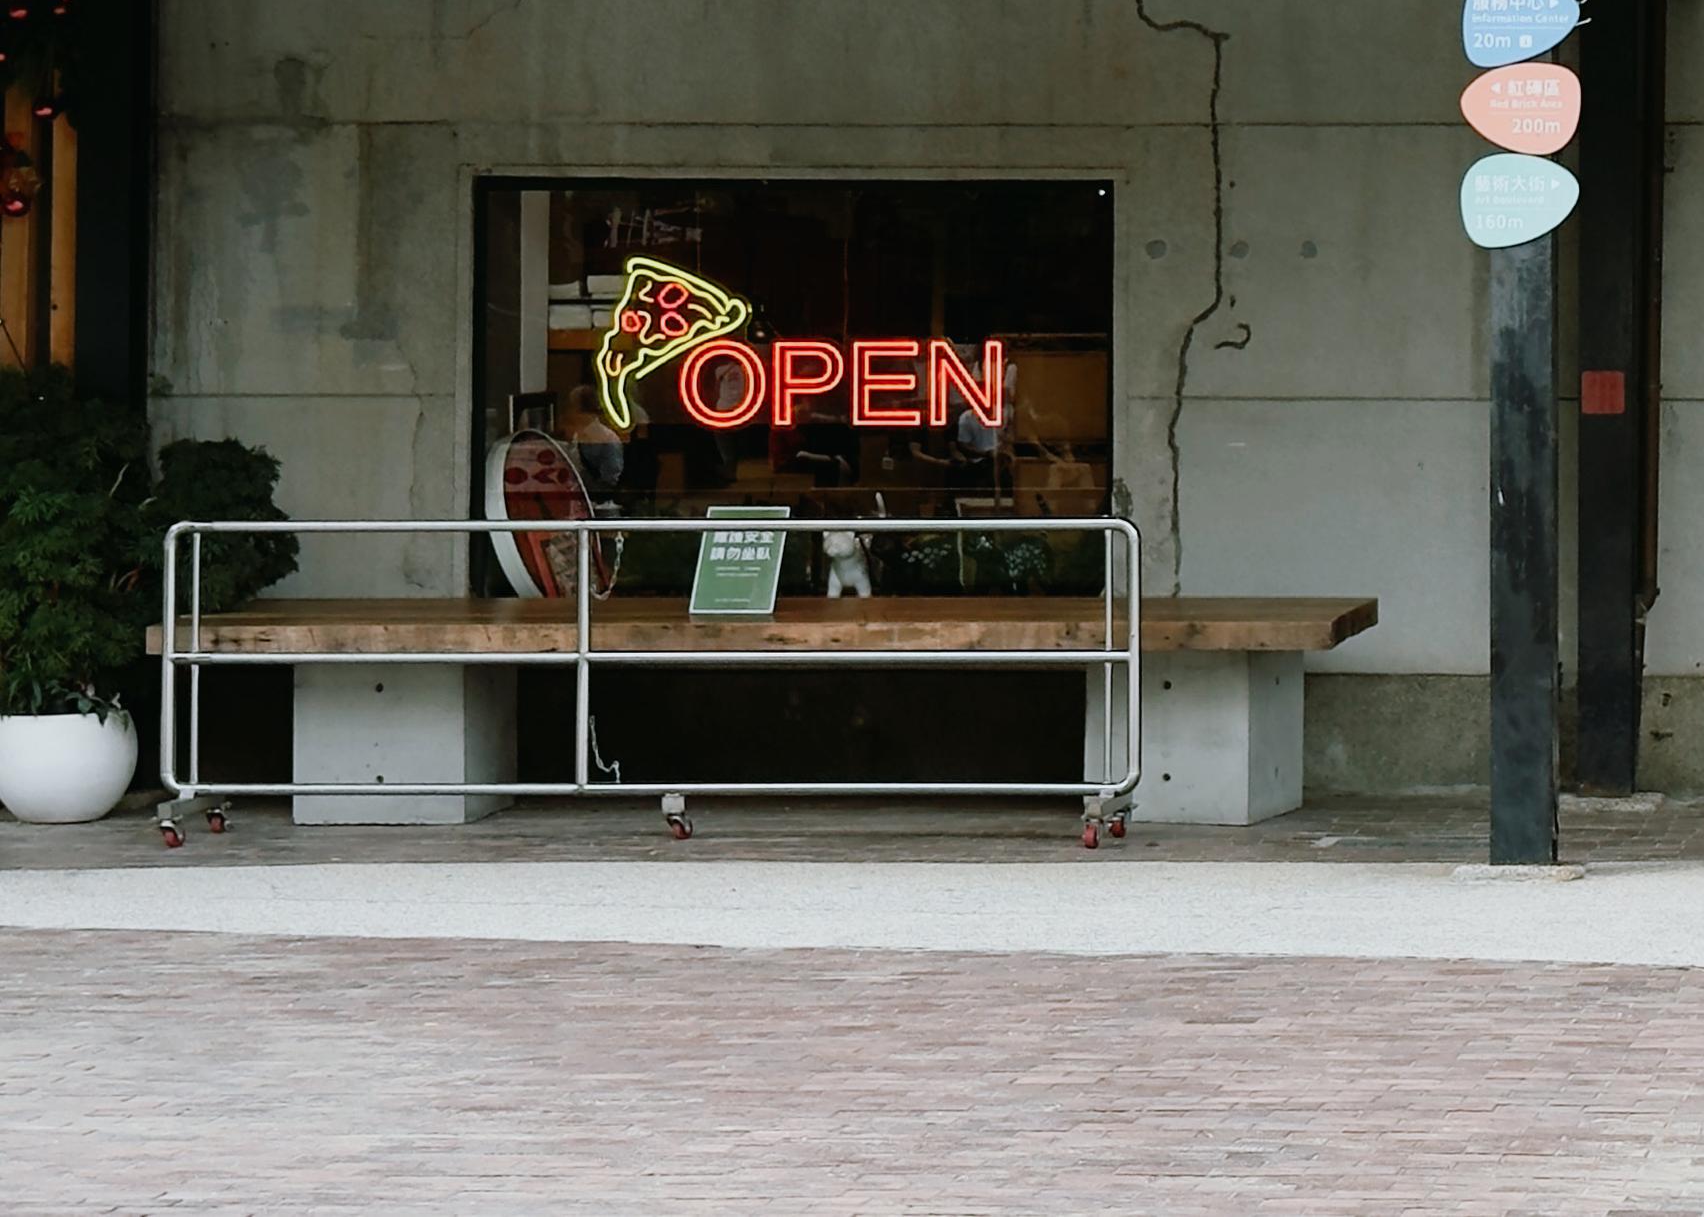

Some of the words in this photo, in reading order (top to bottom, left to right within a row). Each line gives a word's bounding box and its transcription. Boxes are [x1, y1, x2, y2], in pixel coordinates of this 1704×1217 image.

[1471, 13, 1533, 24] Information
[1535, 13, 1569, 24] Center
[1473, 32, 1511, 49] 20m
[1507, 78, 1561, 96] 紅磚區
[1489, 99, 1509, 109] Red
[1511, 99, 1537, 109] Brick
[1511, 117, 1561, 135] 200m
[1475, 213, 1524, 231] 160m
[679, 338, 1003, 428] OPEN
